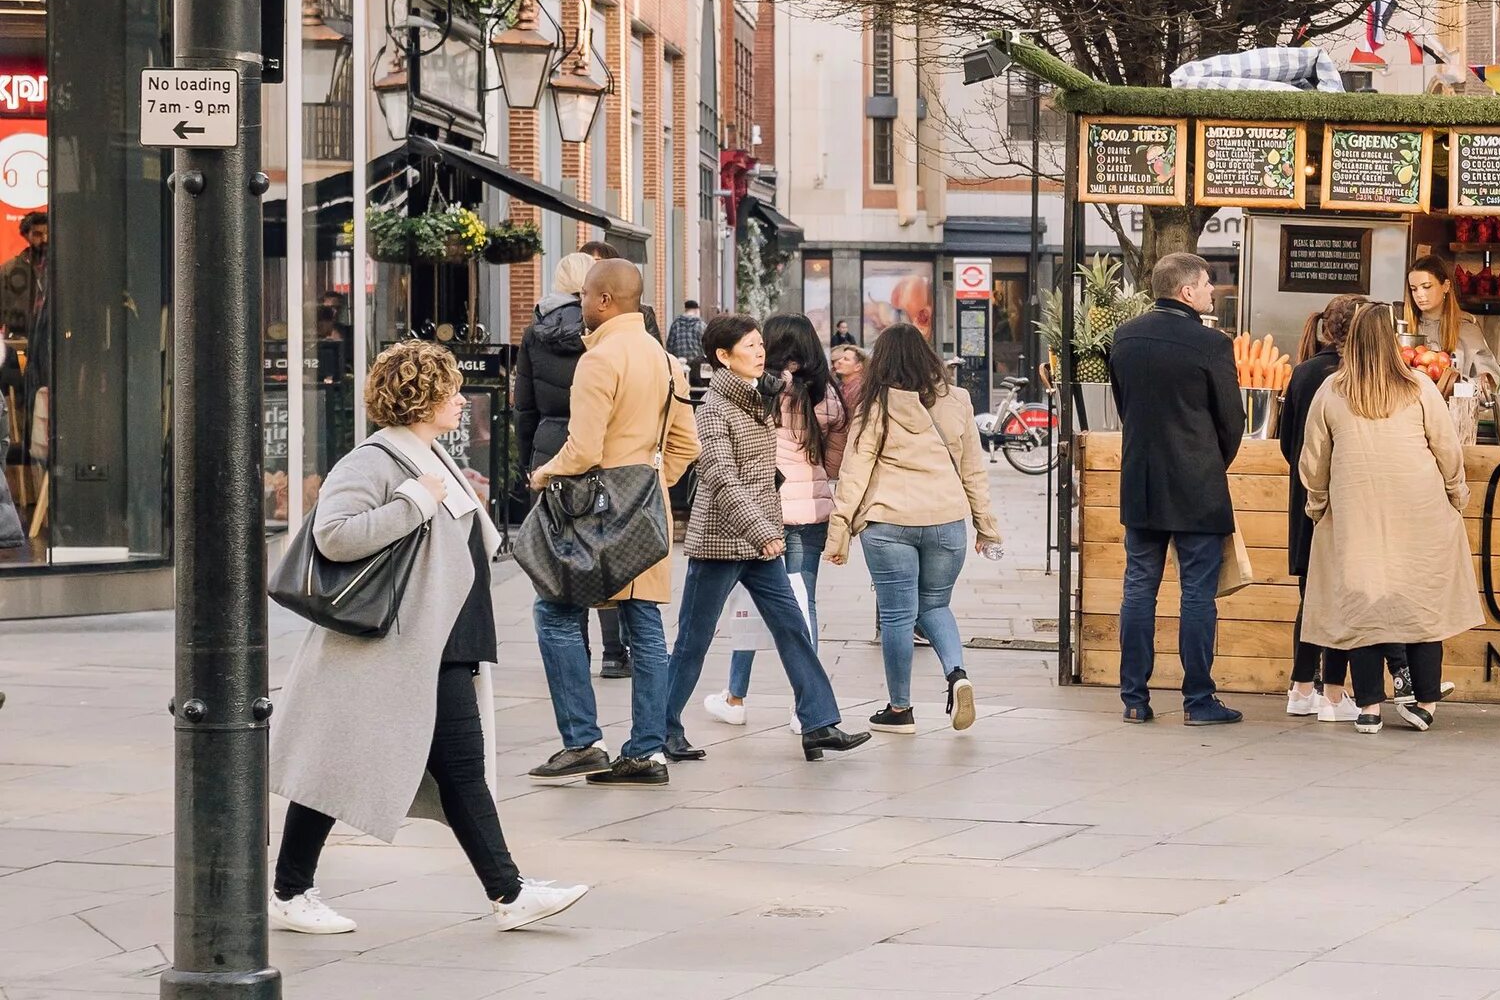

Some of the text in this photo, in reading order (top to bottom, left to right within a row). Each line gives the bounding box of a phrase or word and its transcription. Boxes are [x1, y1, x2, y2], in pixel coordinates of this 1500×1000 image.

[148, 76, 231, 94] No loading
[147, 99, 156, 113] 7
[159, 102, 181, 114] am
[194, 99, 203, 114] 9
[207, 102, 230, 117] pm
[1100, 129, 1168, 142] SOLO JUICES
[1206, 127, 1287, 140] MIXED JUICES
[1216, 139, 1255, 148] STRAWBERRY
[1348, 134, 1399, 150] GREENS
[1107, 147, 1130, 155] ORANGE
[1360, 151, 1381, 159] GINGER
[1383, 152, 1393, 160] ALE
[1107, 156, 1127, 164] APPLE
[1107, 165, 1132, 173] CARROT
[1341, 163, 1373, 171] CLEANSING
[1106, 173, 1151, 182] WATERMELON
[1215, 173, 1236, 181] MINTY
[1340, 173, 1386, 182] SUPER GREENS
[1472, 173, 1500, 181] ENERGY
[1090, 184, 1107, 193] SMALL
[1119, 185, 1136, 194] LARGE
[1145, 186, 1165, 194] BOTTLE
[1235, 187, 1250, 195] LARGE
[1333, 186, 1348, 194] SMALL
[1384, 188, 1404, 196] BOTTLE
[1462, 187, 1478, 195] SMALL
[1356, 193, 1391, 203] Cash Only
[457, 360, 486, 371] AGLE
